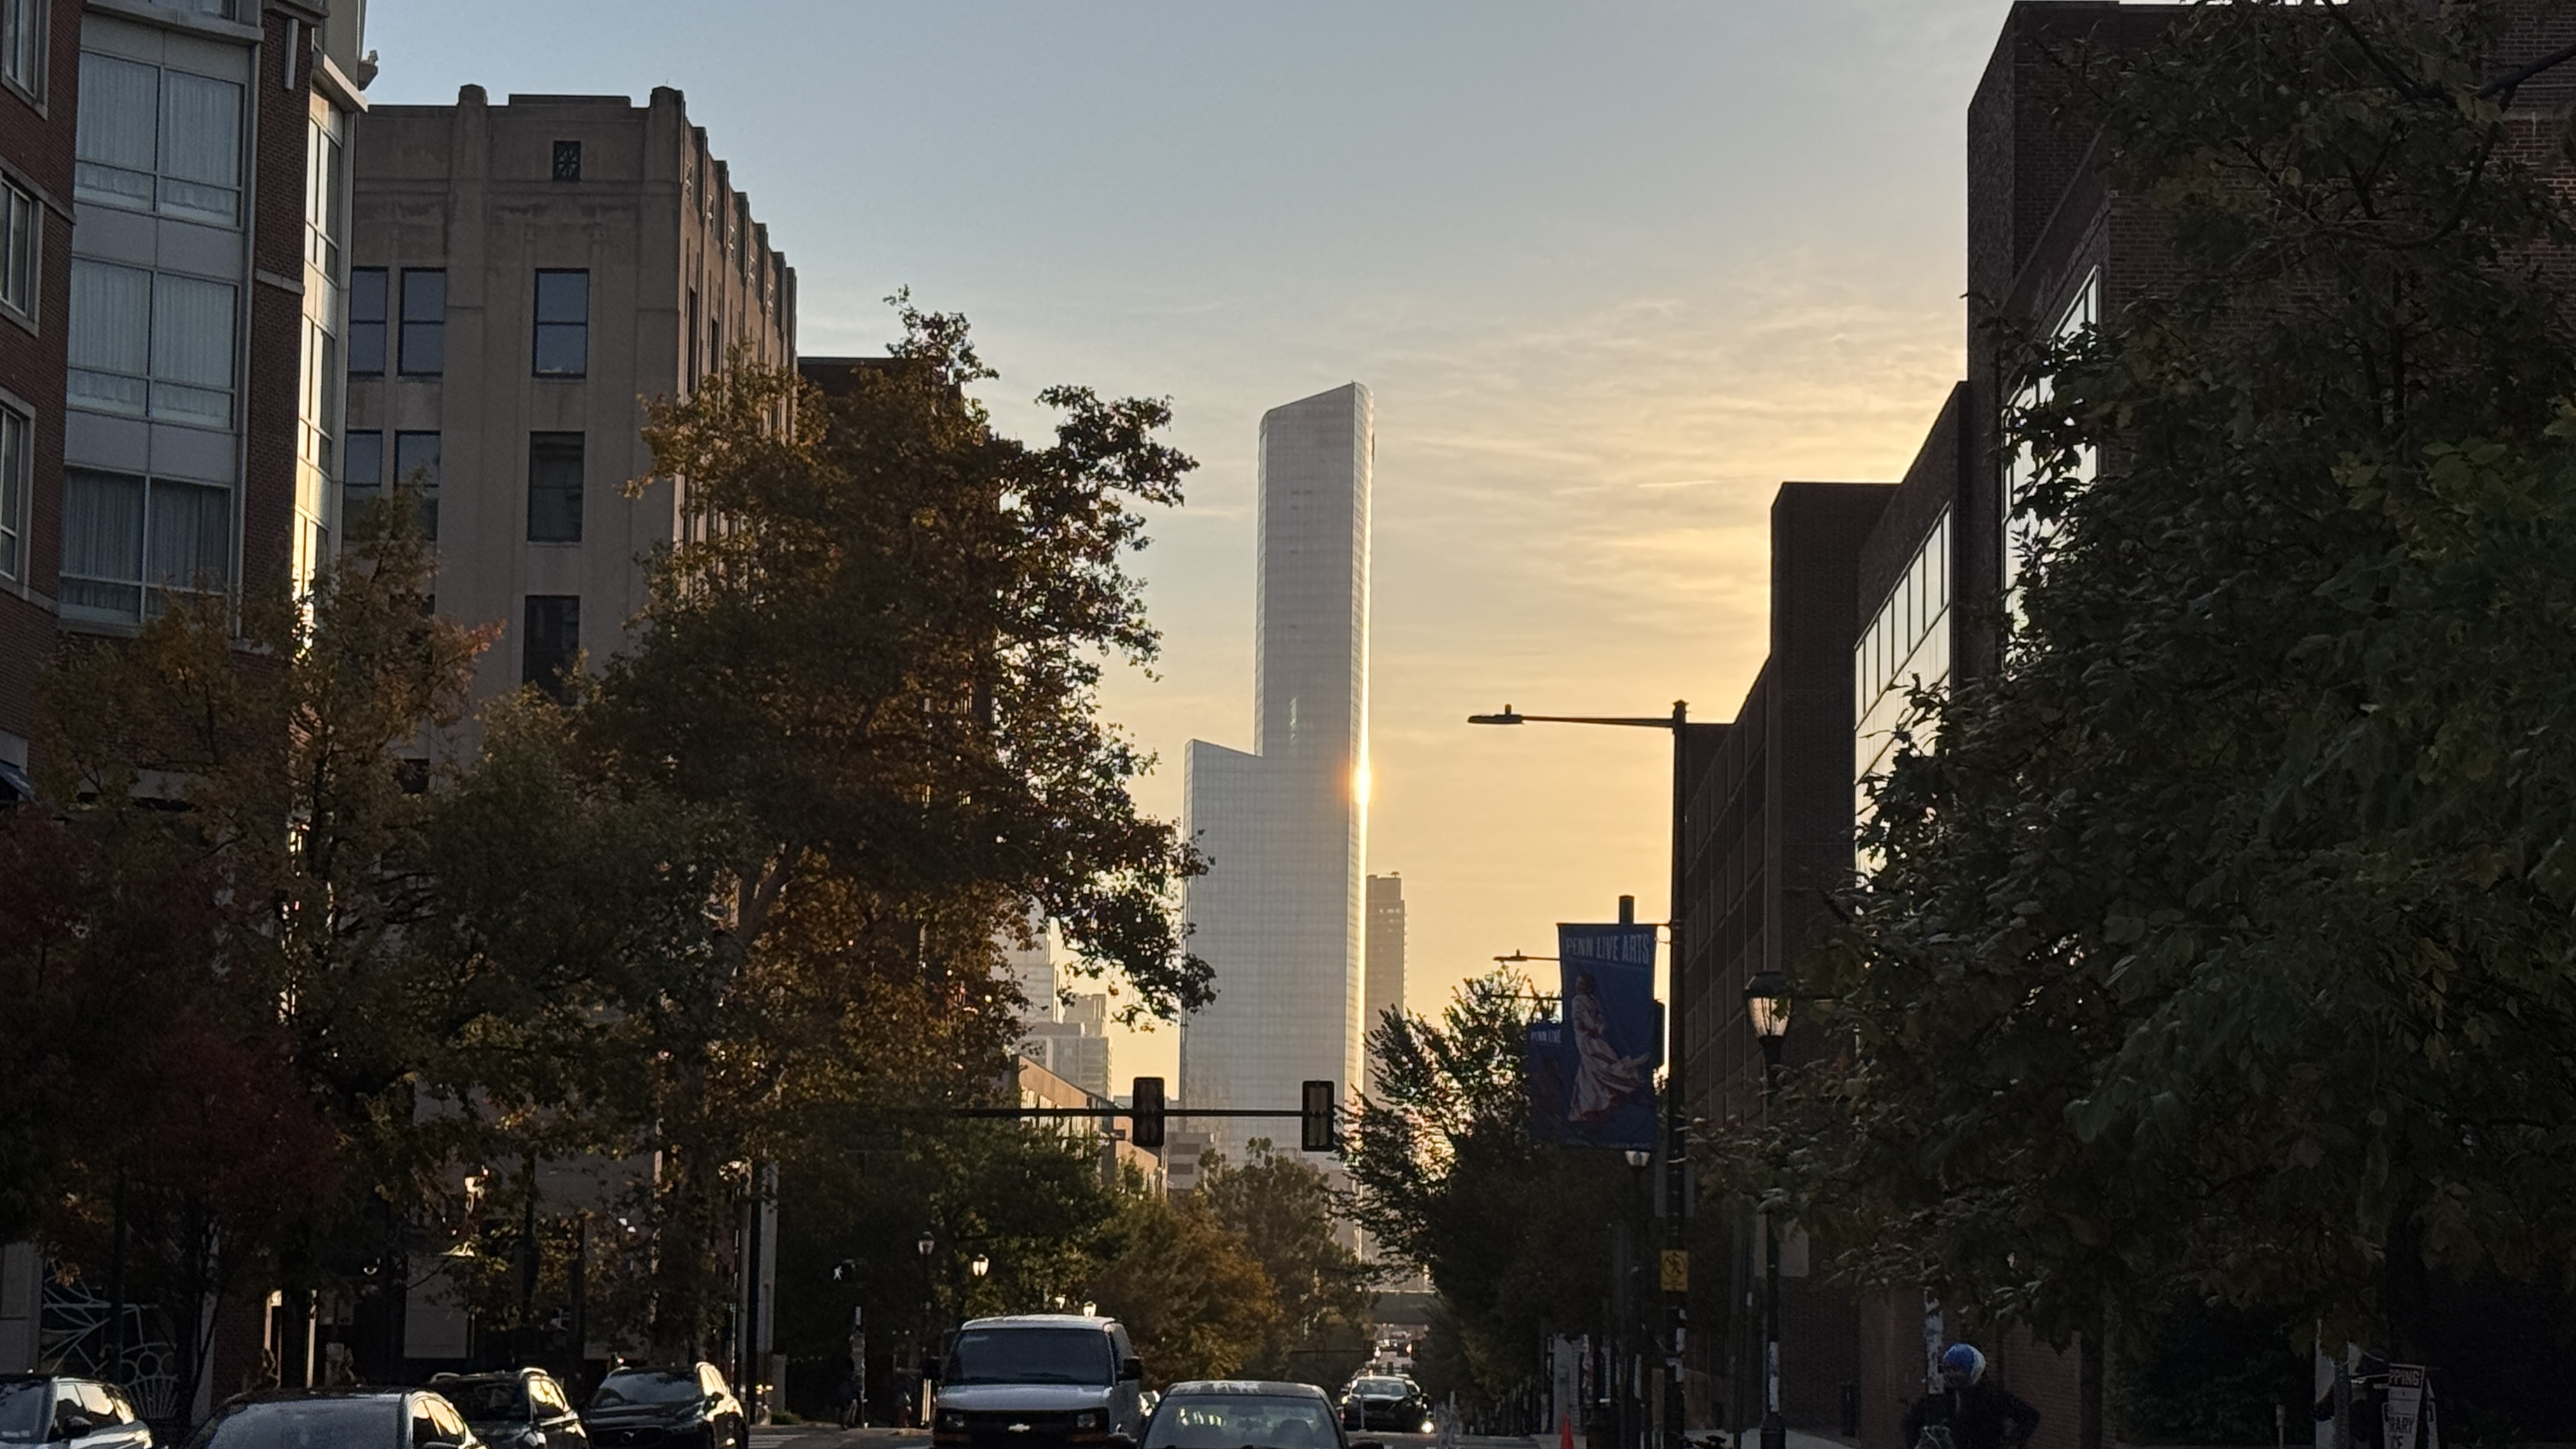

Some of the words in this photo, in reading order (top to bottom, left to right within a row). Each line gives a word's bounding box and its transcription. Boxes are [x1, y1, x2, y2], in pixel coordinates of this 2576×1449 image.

[1565, 936, 1593, 957] PENN
[1596, 935, 1620, 962] LIVE
[1621, 933, 1650, 965] ARTS
